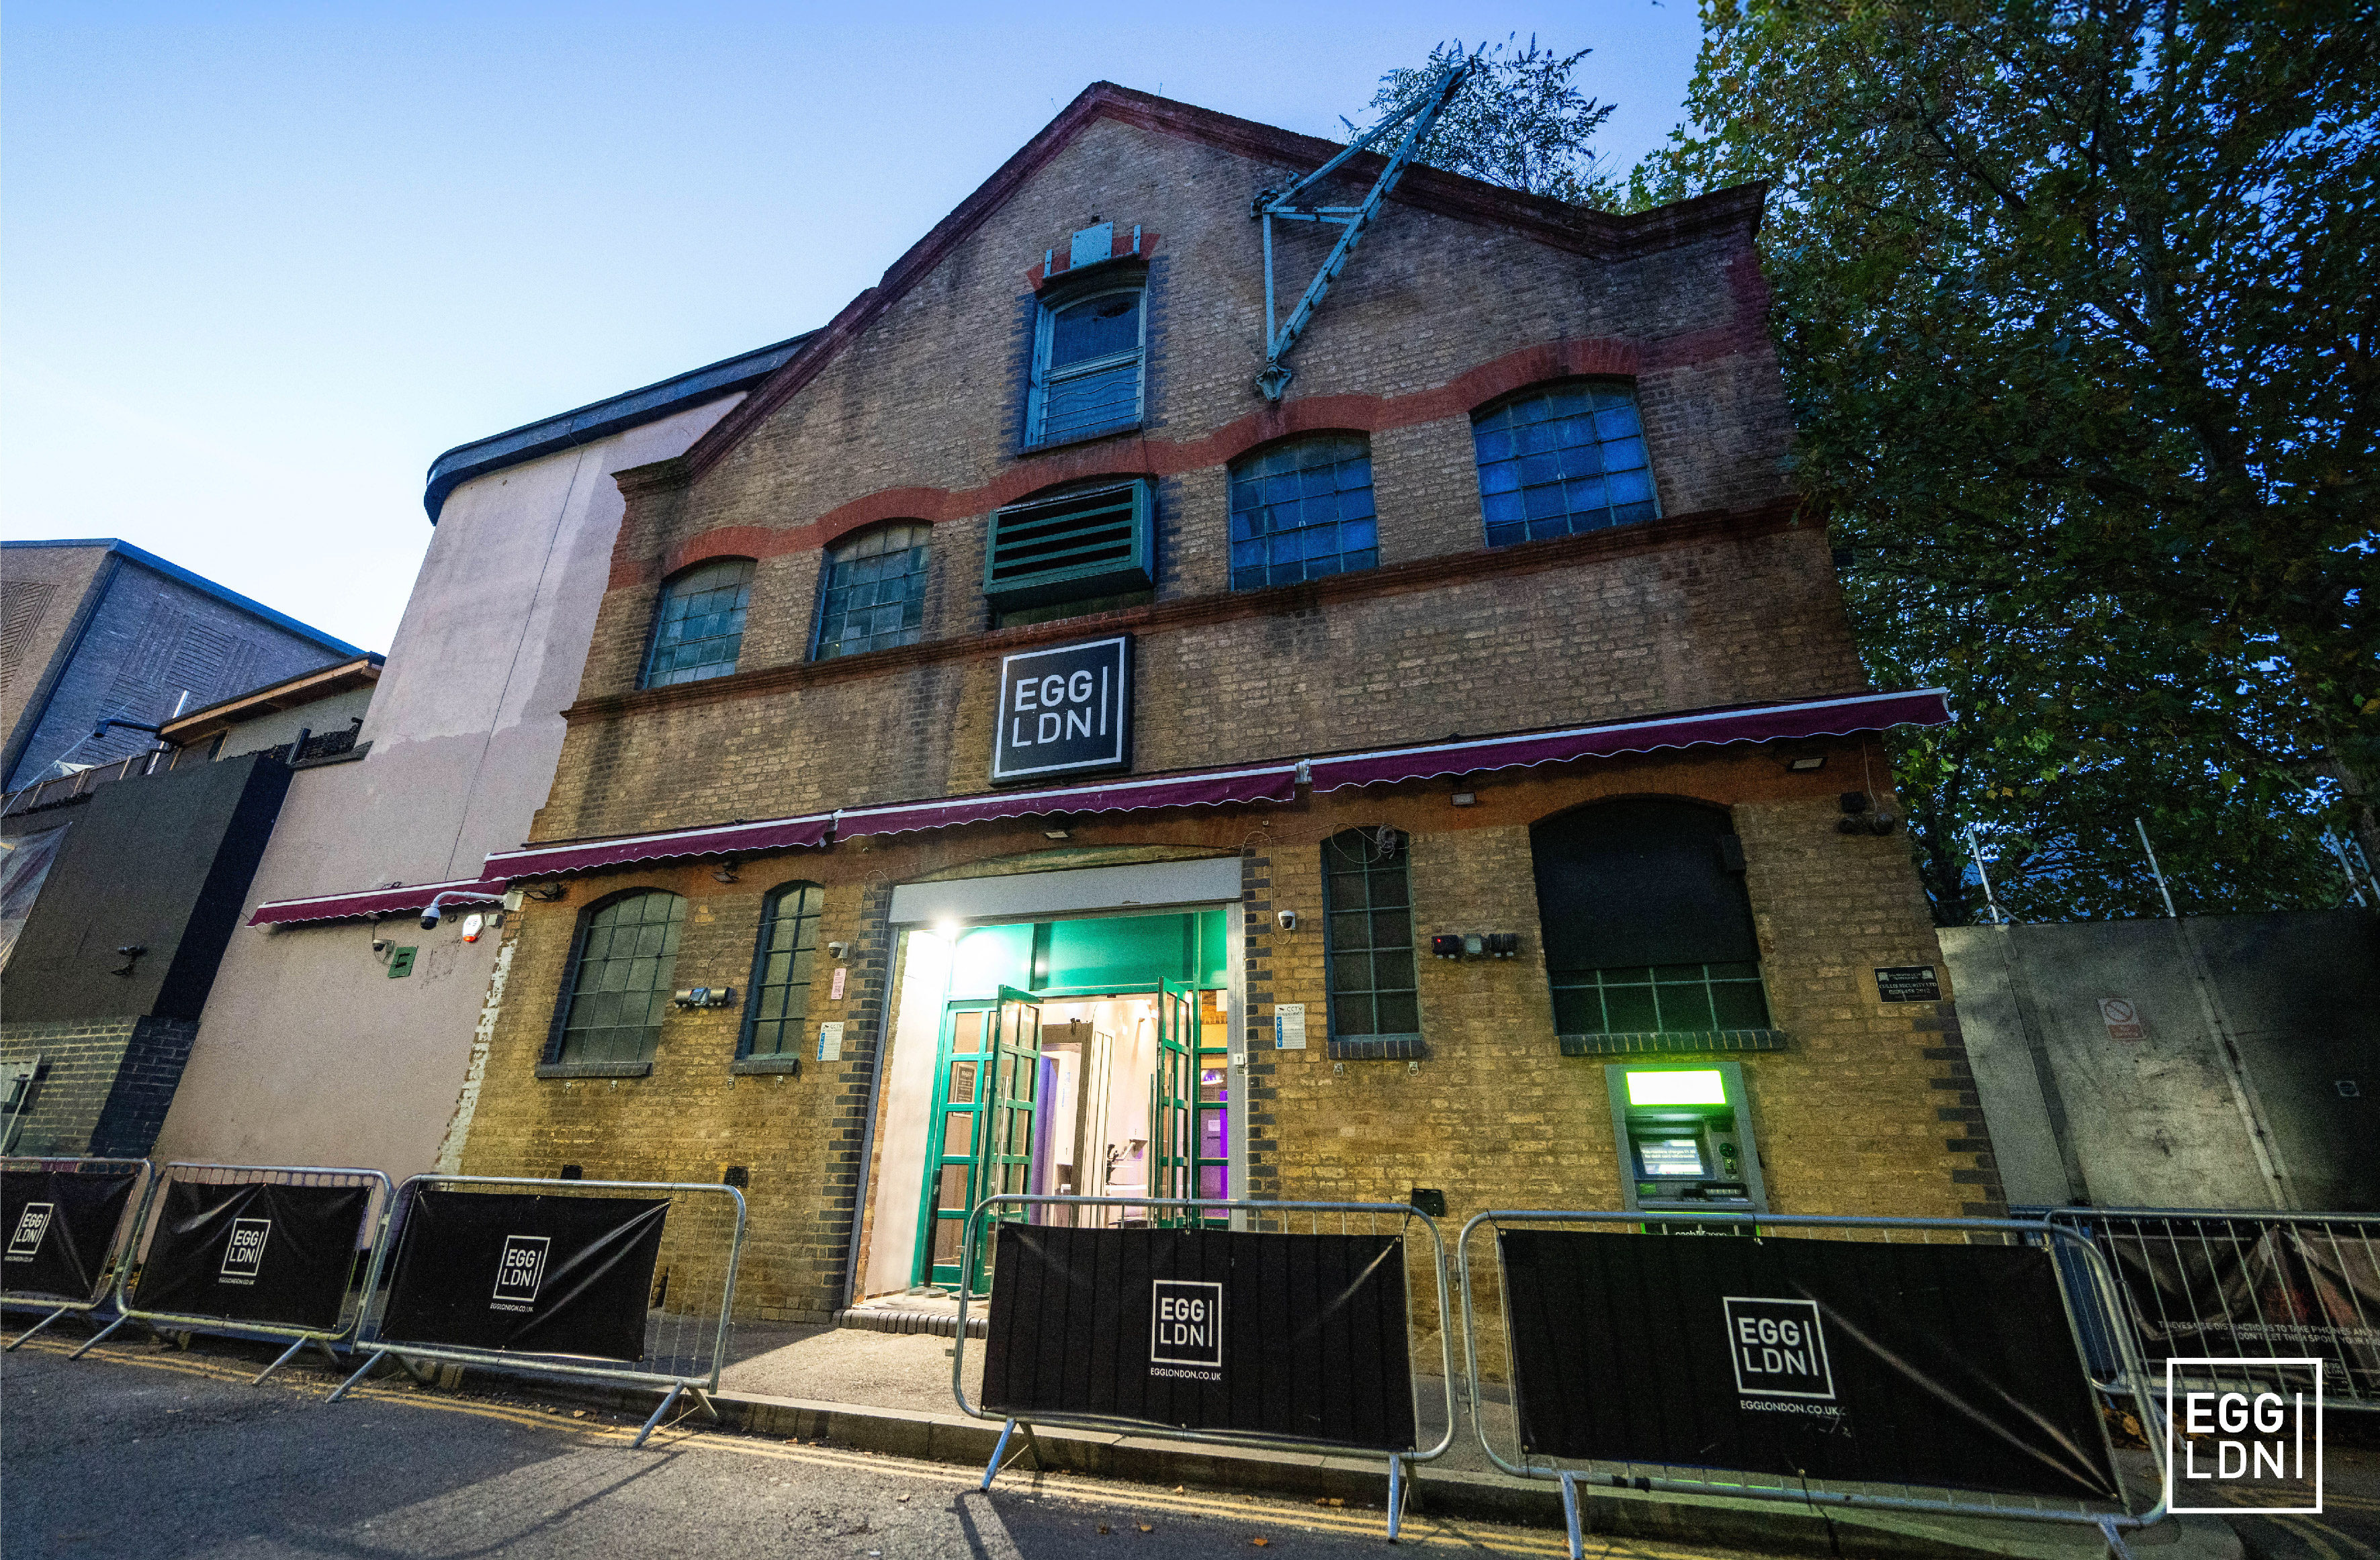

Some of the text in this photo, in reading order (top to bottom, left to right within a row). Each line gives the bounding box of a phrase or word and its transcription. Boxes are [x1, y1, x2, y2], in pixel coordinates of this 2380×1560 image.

[1014, 670, 1094, 712] EGG
[1012, 707, 1092, 747] LDN
[21, 1213, 44, 1228] EGG
[15, 1228, 38, 1242] LDN
[233, 1230, 259, 1247] EGG
[229, 1247, 255, 1263] LDN
[505, 1248, 537, 1268] EGG
[501, 1268, 533, 1287] LDN
[490, 1303, 534, 1312] EGGLONDON.CO.UK
[1161, 1297, 1204, 1322] EGG
[1160, 1322, 1204, 1346] LDN
[1737, 1317, 1800, 1346] EGG
[2213, 1322, 2275, 1332] DISRACTIOS
[2275, 1324, 2287, 1333] TO
[2308, 1334, 2337, 1343] SPOI
[1742, 1347, 1808, 1375] LDN
[1150, 1367, 1221, 1381] EGGLONDON.CO.UK
[1740, 1400, 1839, 1416] EGGLONDON.CO.UK
